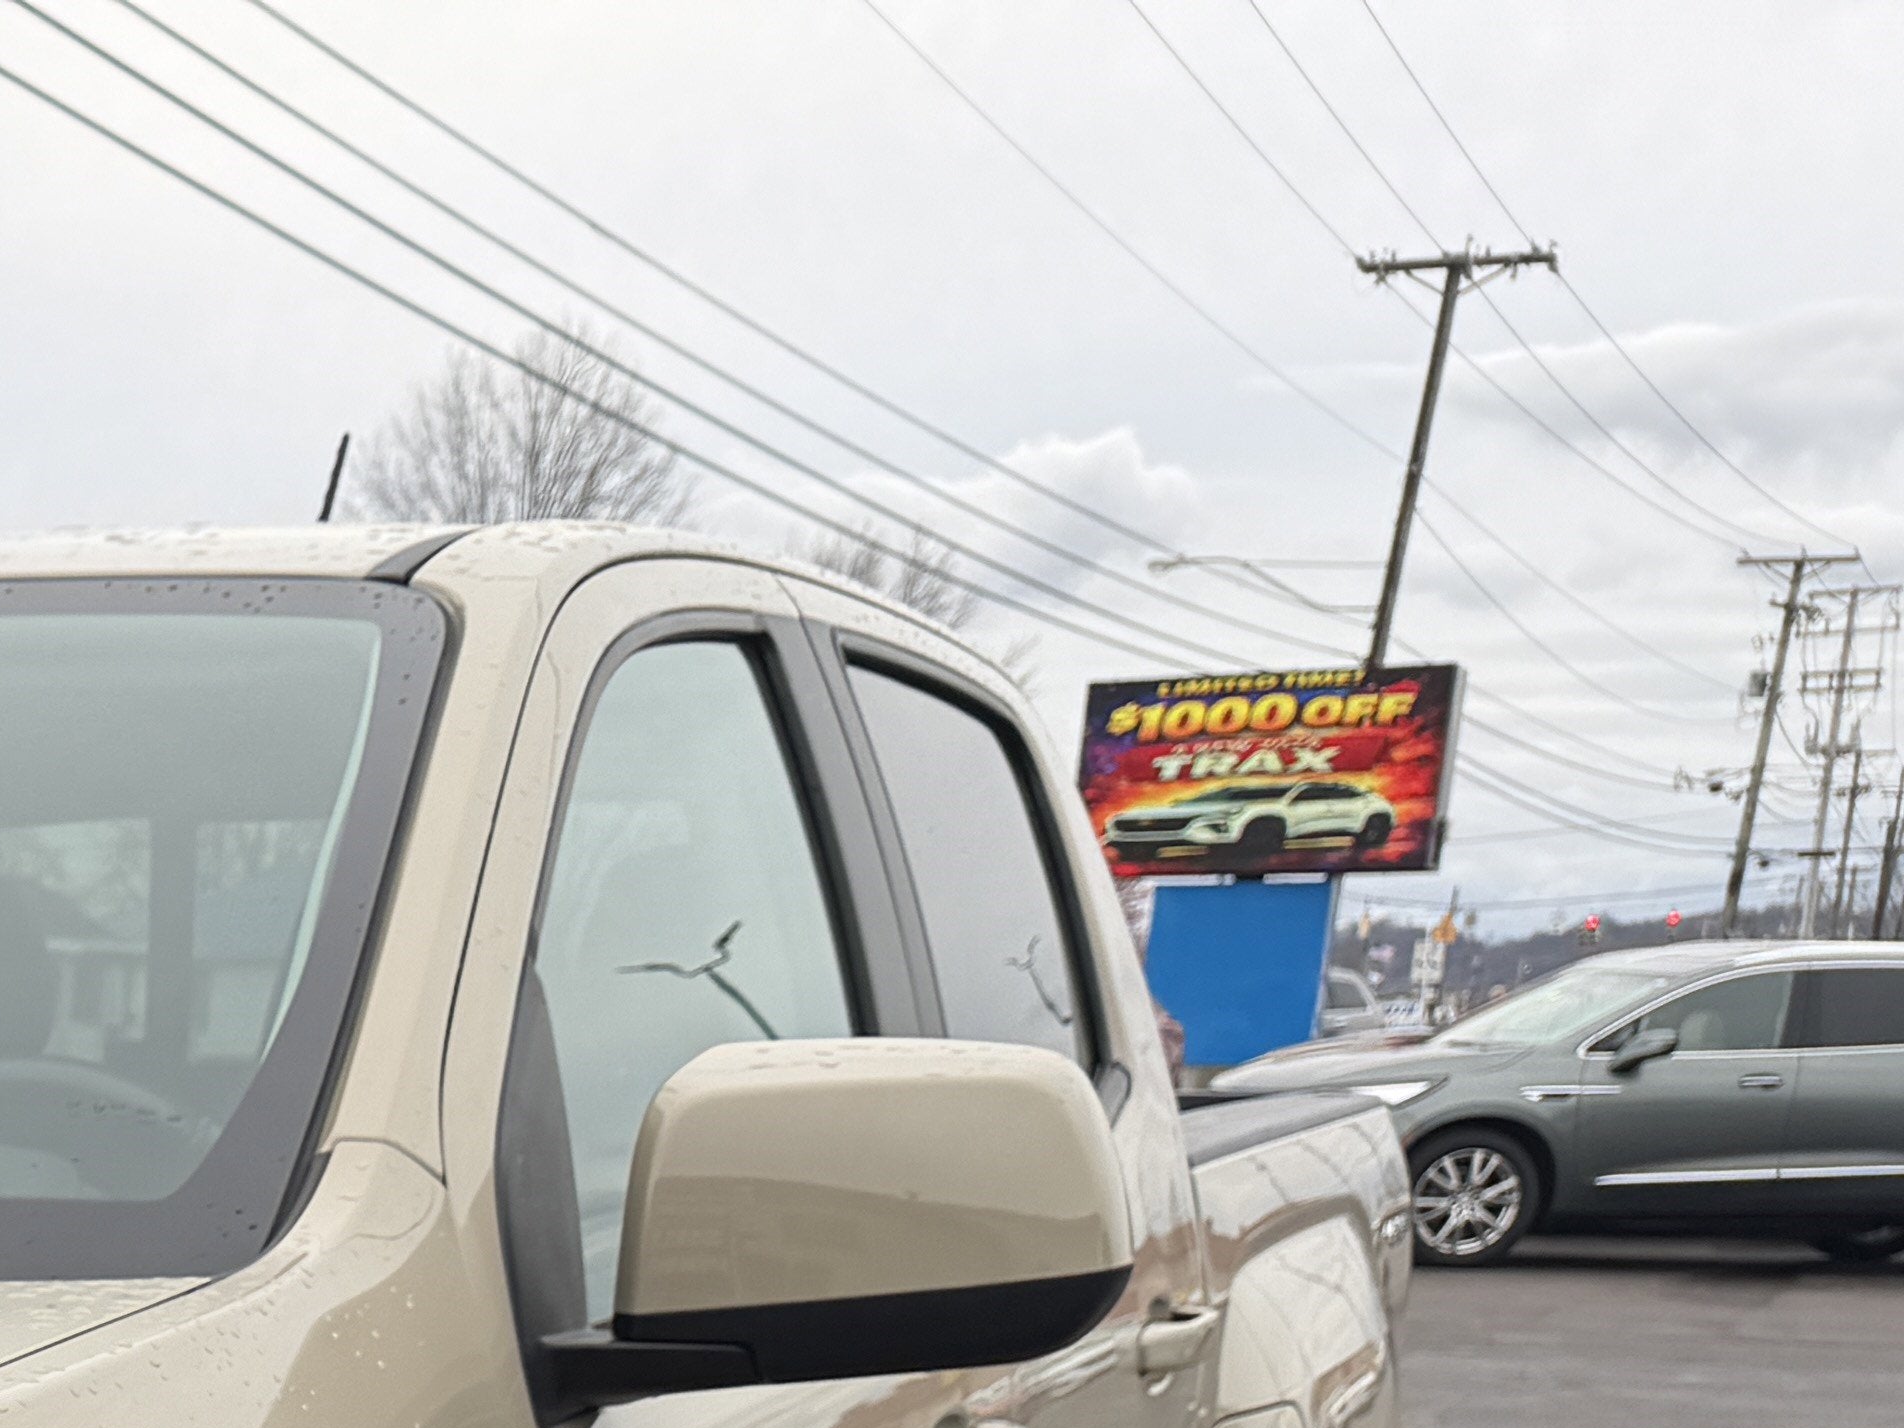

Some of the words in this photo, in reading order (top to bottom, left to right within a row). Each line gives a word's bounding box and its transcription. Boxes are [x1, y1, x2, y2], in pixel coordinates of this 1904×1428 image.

[1106, 692, 1299, 742] $1000
[1302, 691, 1420, 728] OFF
[1152, 746, 1342, 782] TRAX
